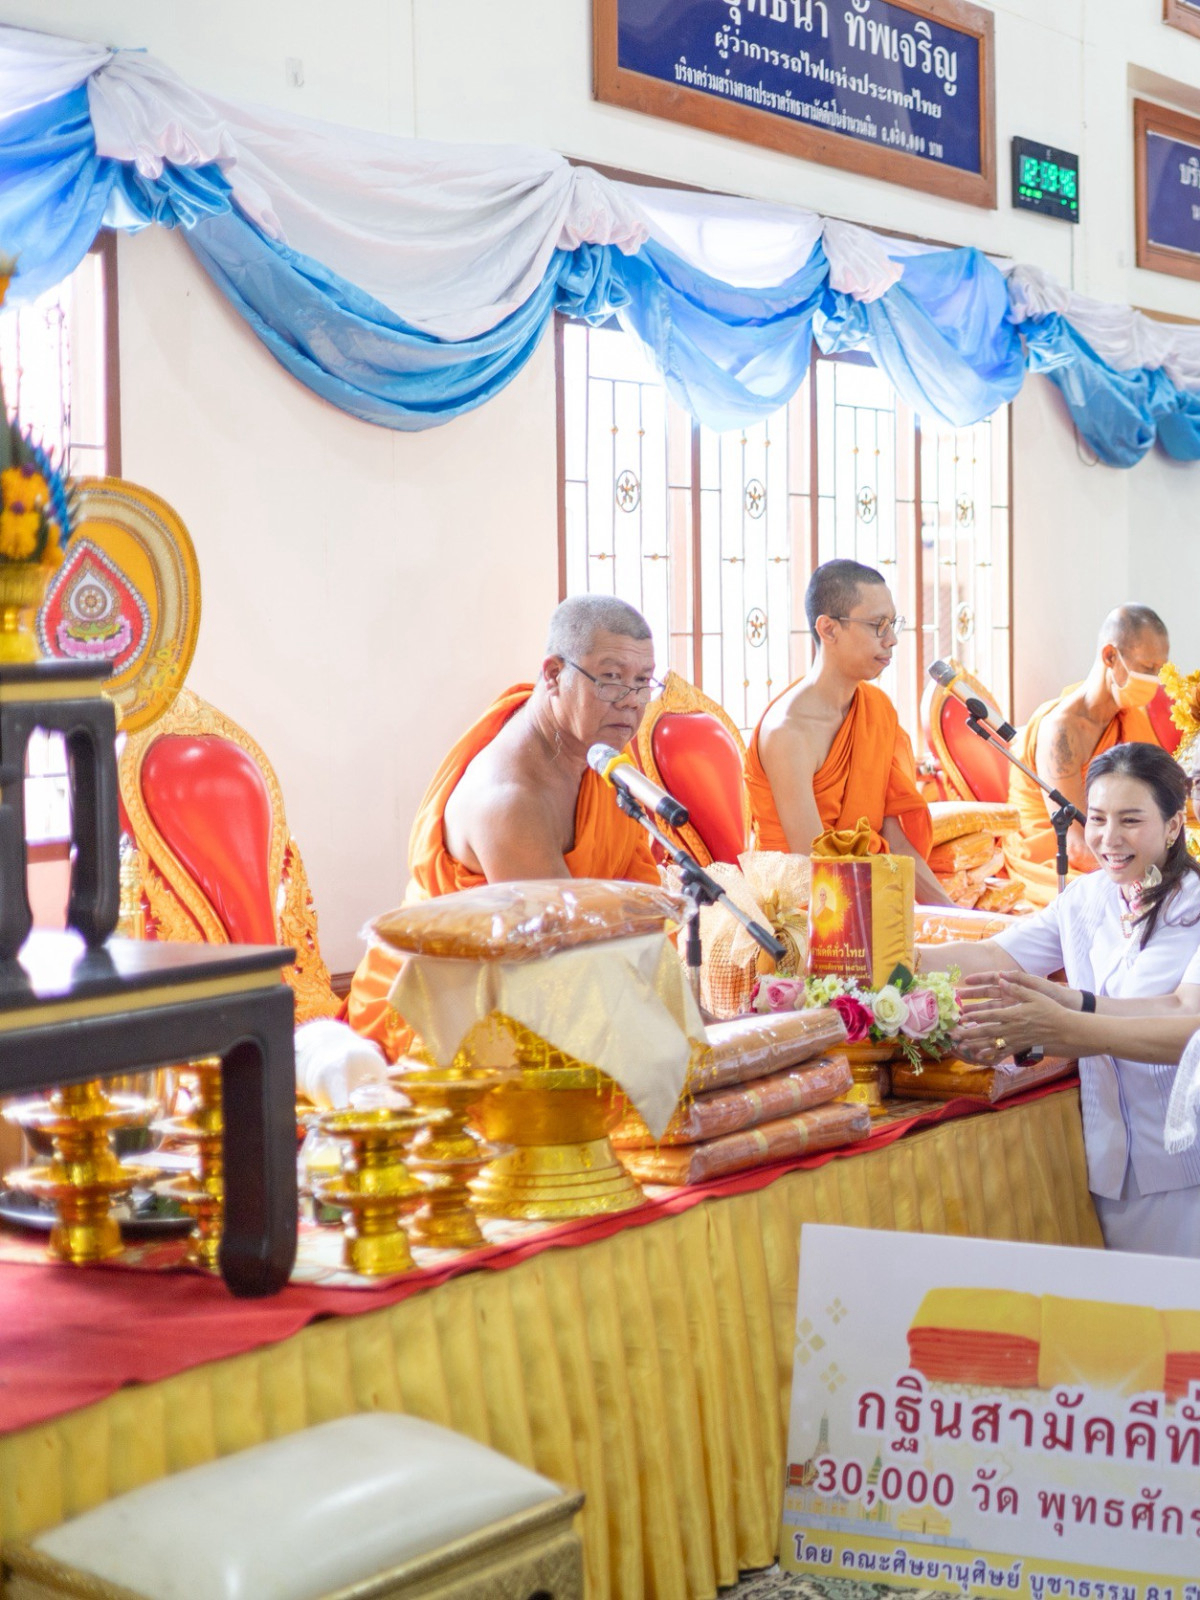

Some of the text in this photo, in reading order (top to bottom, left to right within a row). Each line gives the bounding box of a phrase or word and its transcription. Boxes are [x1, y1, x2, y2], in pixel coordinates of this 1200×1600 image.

[715, 25, 942, 118] ผู้ว่าการรถไฟแห่งประเทศไทย
[817, 1458, 955, 1506] 30,000
[972, 1467, 1019, 1515] วัด
[794, 1535, 832, 1564] โดย
[841, 1550, 1023, 1592] คณะศิษยานุศิษย์
[1029, 1573, 1136, 1600] บูชาธรรม
